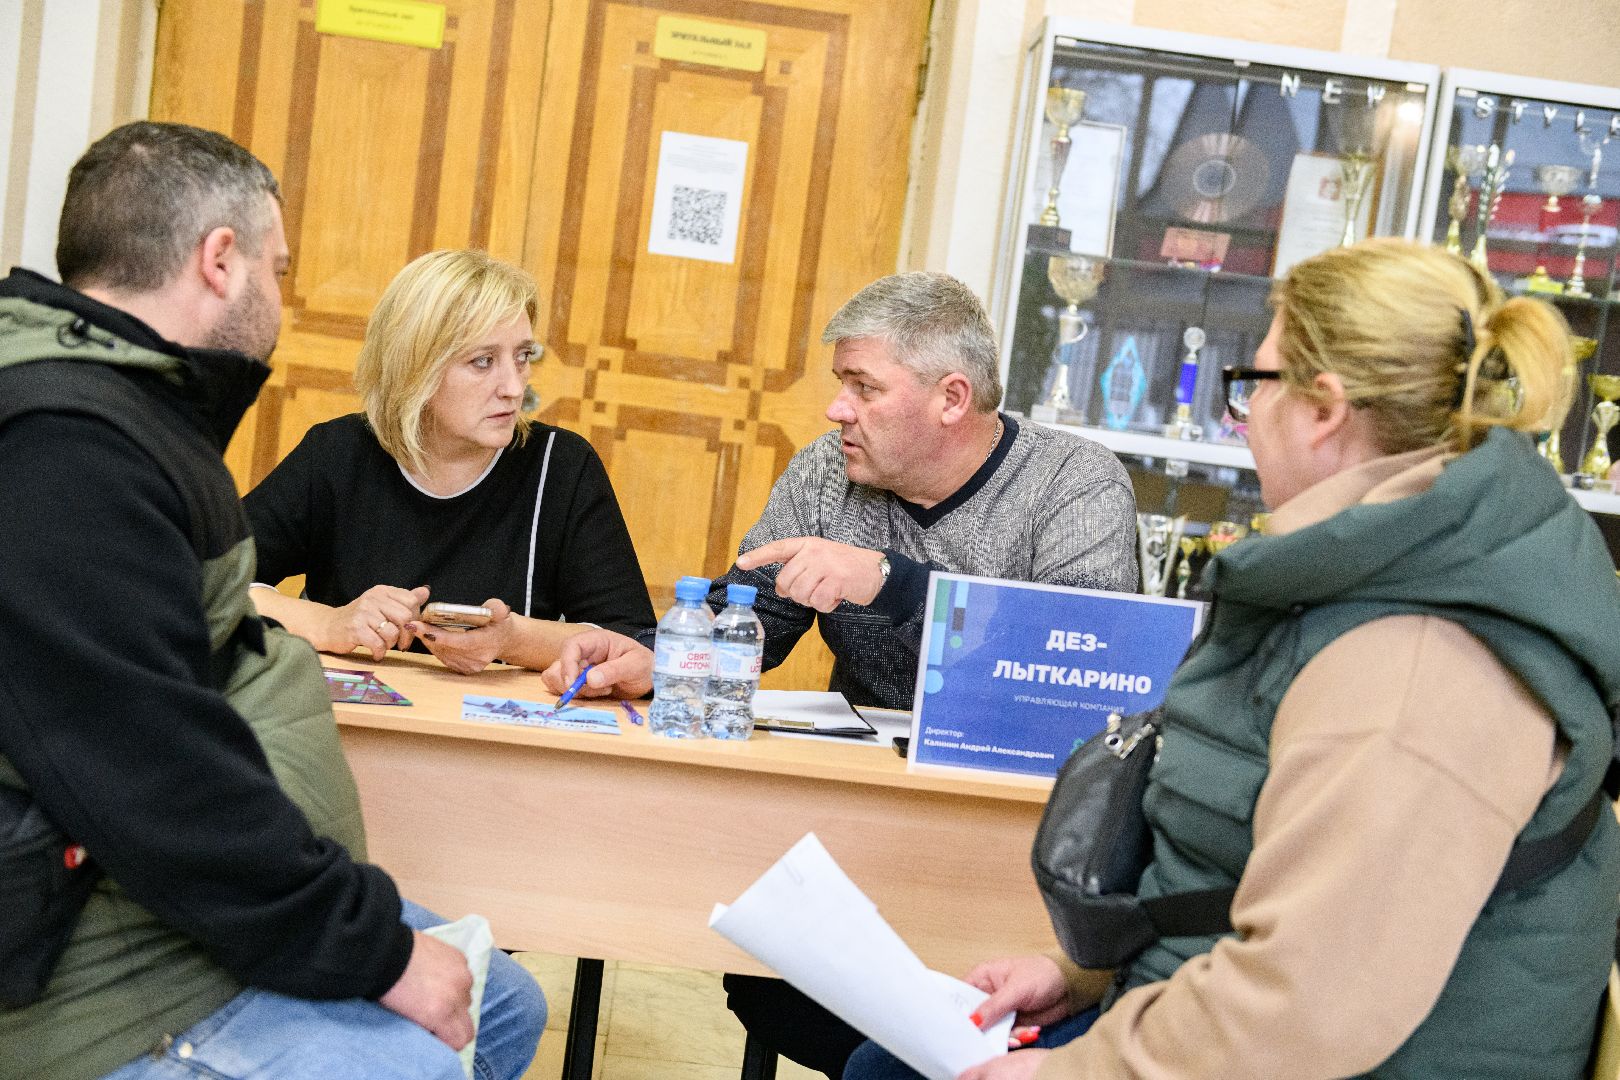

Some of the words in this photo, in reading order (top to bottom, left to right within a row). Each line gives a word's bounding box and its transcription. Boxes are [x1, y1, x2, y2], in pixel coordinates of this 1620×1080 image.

[1280, 73, 1386, 106] NEW
[1045, 629, 1108, 652] ДЕЗ-
[992, 659, 1152, 694] ЛЫТКАРИНО
[1014, 695, 1078, 708] УПРАВЛЯЮЩАЯ
[1080, 702, 1125, 713] КОМПАНИЯ
[925, 726, 964, 738] Директор:
[923, 738, 959, 749] Калинин
[960, 742, 991, 752] Андрей
[991, 746, 1055, 759] Александрович
